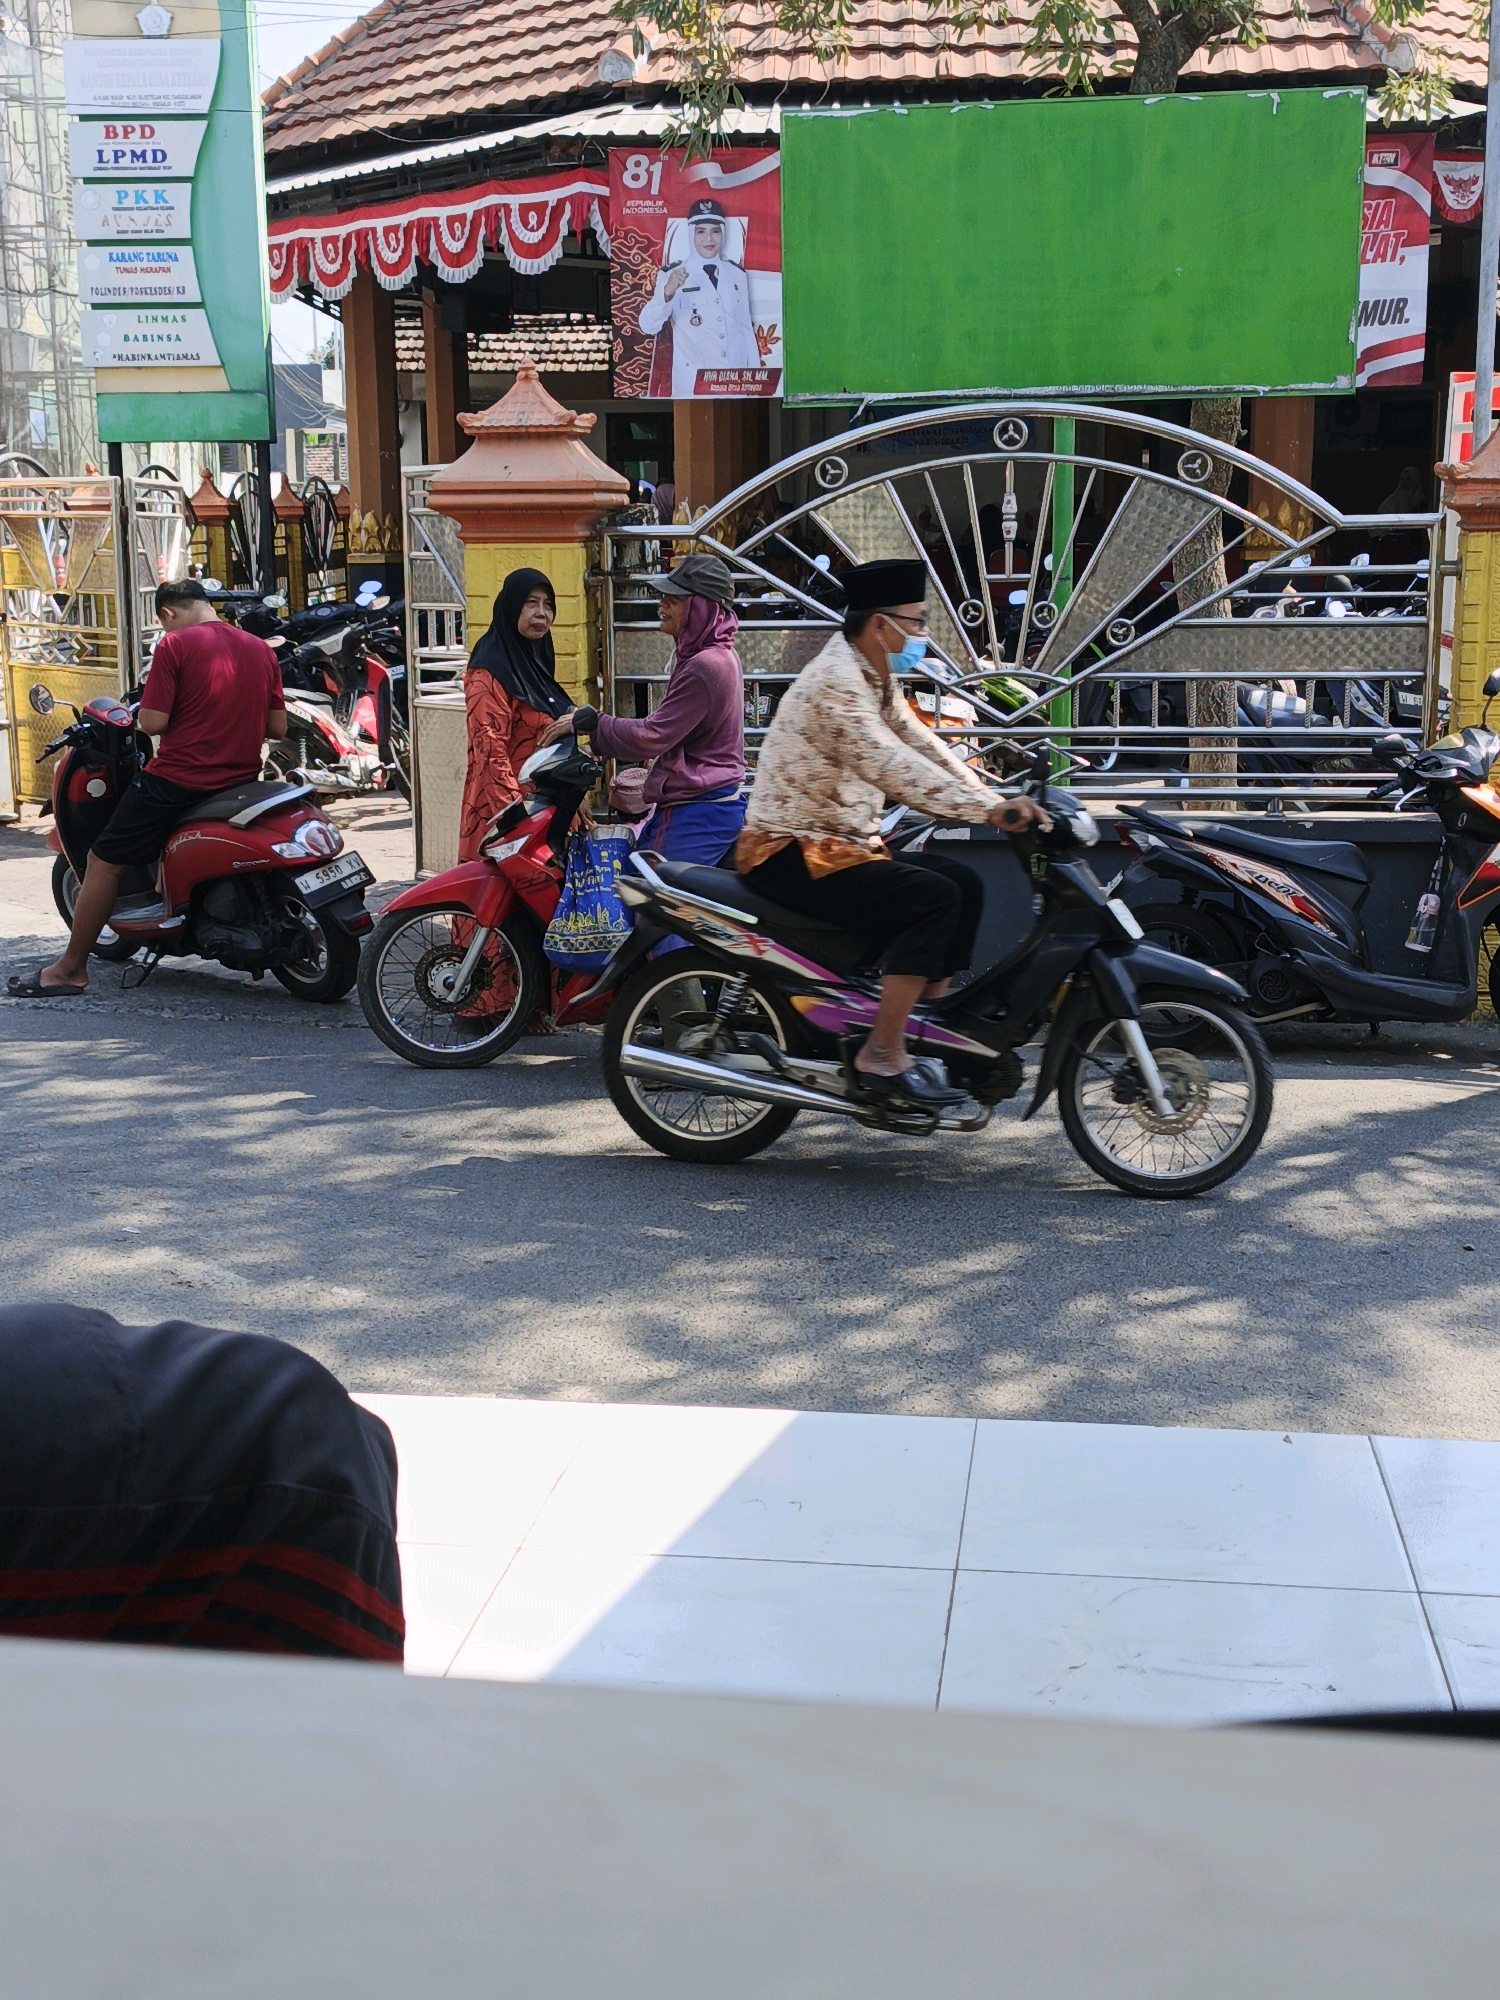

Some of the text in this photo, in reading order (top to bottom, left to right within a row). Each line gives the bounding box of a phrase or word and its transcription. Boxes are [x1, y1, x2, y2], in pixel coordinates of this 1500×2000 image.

[103, 124, 156, 140] BPD
[96, 148, 168, 164] LPMD
[622, 154, 663, 195] 81
[115, 189, 170, 205] PKK
[622, 207, 669, 215] INDONESIA
[108, 252, 180, 263] KARANG TARUNA
[137, 315, 187, 324] LINMAS
[123, 333, 182, 343] BABINSA
[300, 879, 311, 891] W
[315, 864, 343, 884] 5950
